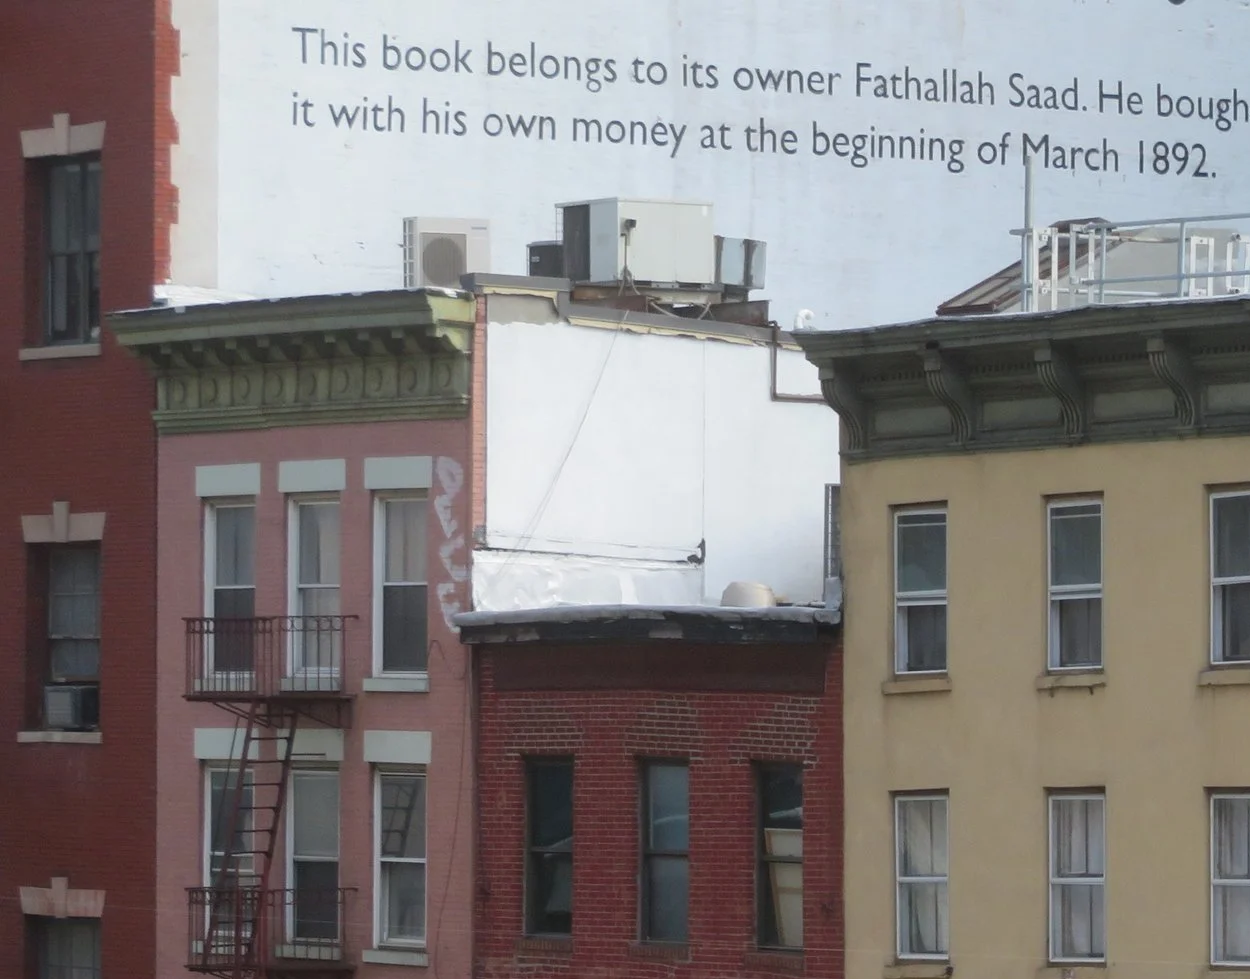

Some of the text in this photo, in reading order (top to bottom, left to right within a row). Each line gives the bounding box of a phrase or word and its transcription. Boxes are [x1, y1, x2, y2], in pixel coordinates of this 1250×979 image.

[291, 27, 367, 68] This
[381, 33, 473, 74] book
[487, 41, 617, 93] belongs
[632, 56, 668, 85] to
[682, 54, 719, 89] its
[733, 69, 841, 96] owner
[855, 63, 995, 106] Fathallah
[1008, 73, 1087, 111] Saad.
[1099, 80, 1143, 115] He
[291, 91, 1217, 178] it with his own money at the beginning of March 1892.
